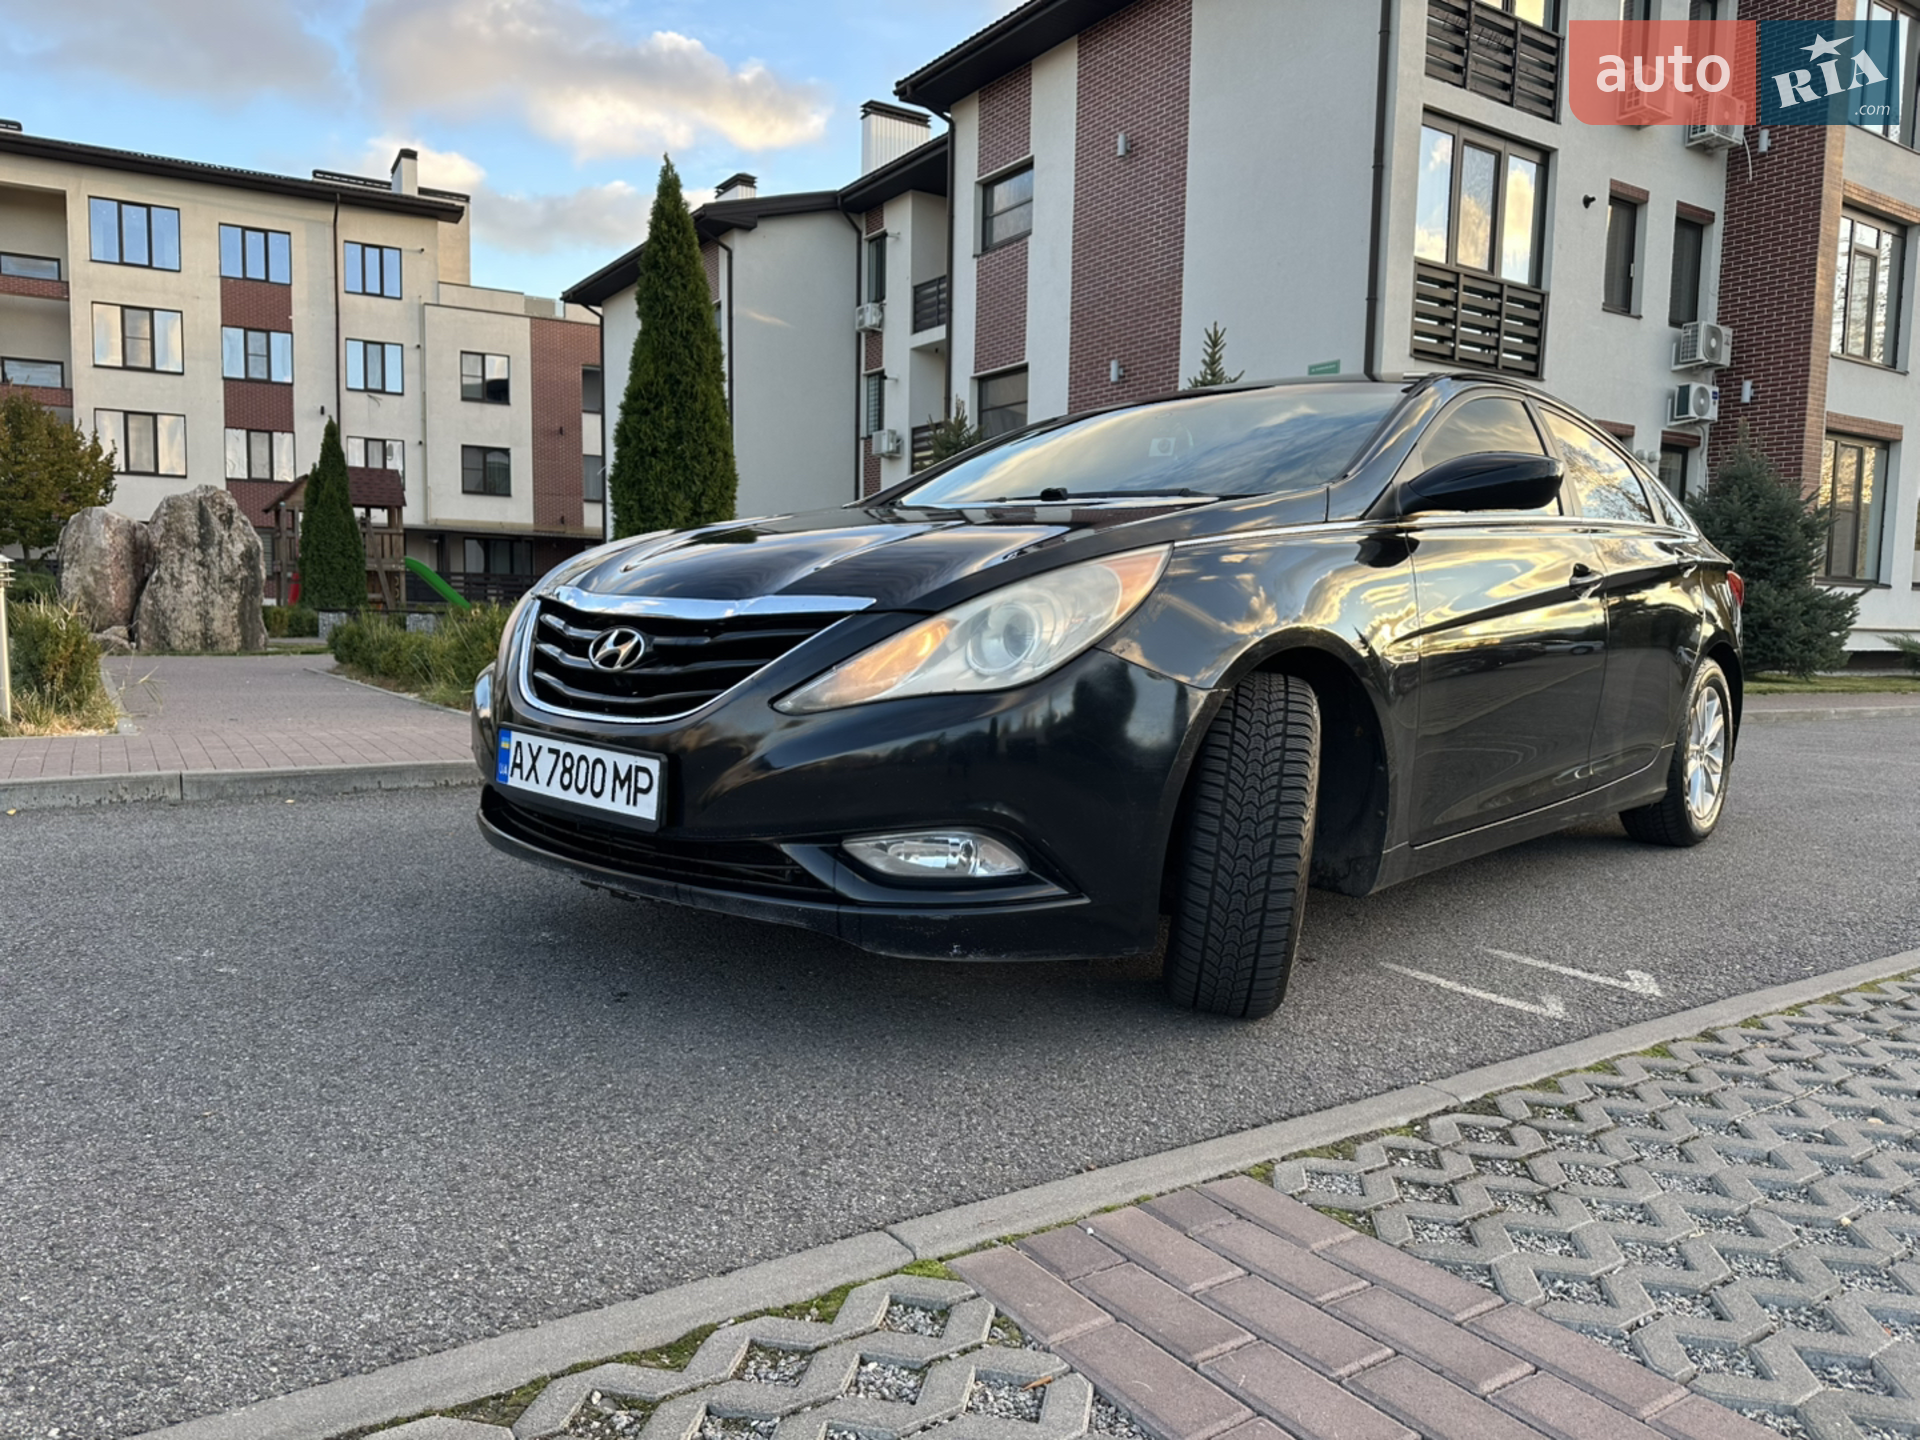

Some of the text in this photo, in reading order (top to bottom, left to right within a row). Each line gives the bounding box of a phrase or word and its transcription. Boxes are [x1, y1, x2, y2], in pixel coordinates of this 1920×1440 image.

[510, 741, 653, 806] AX 7800 MP
